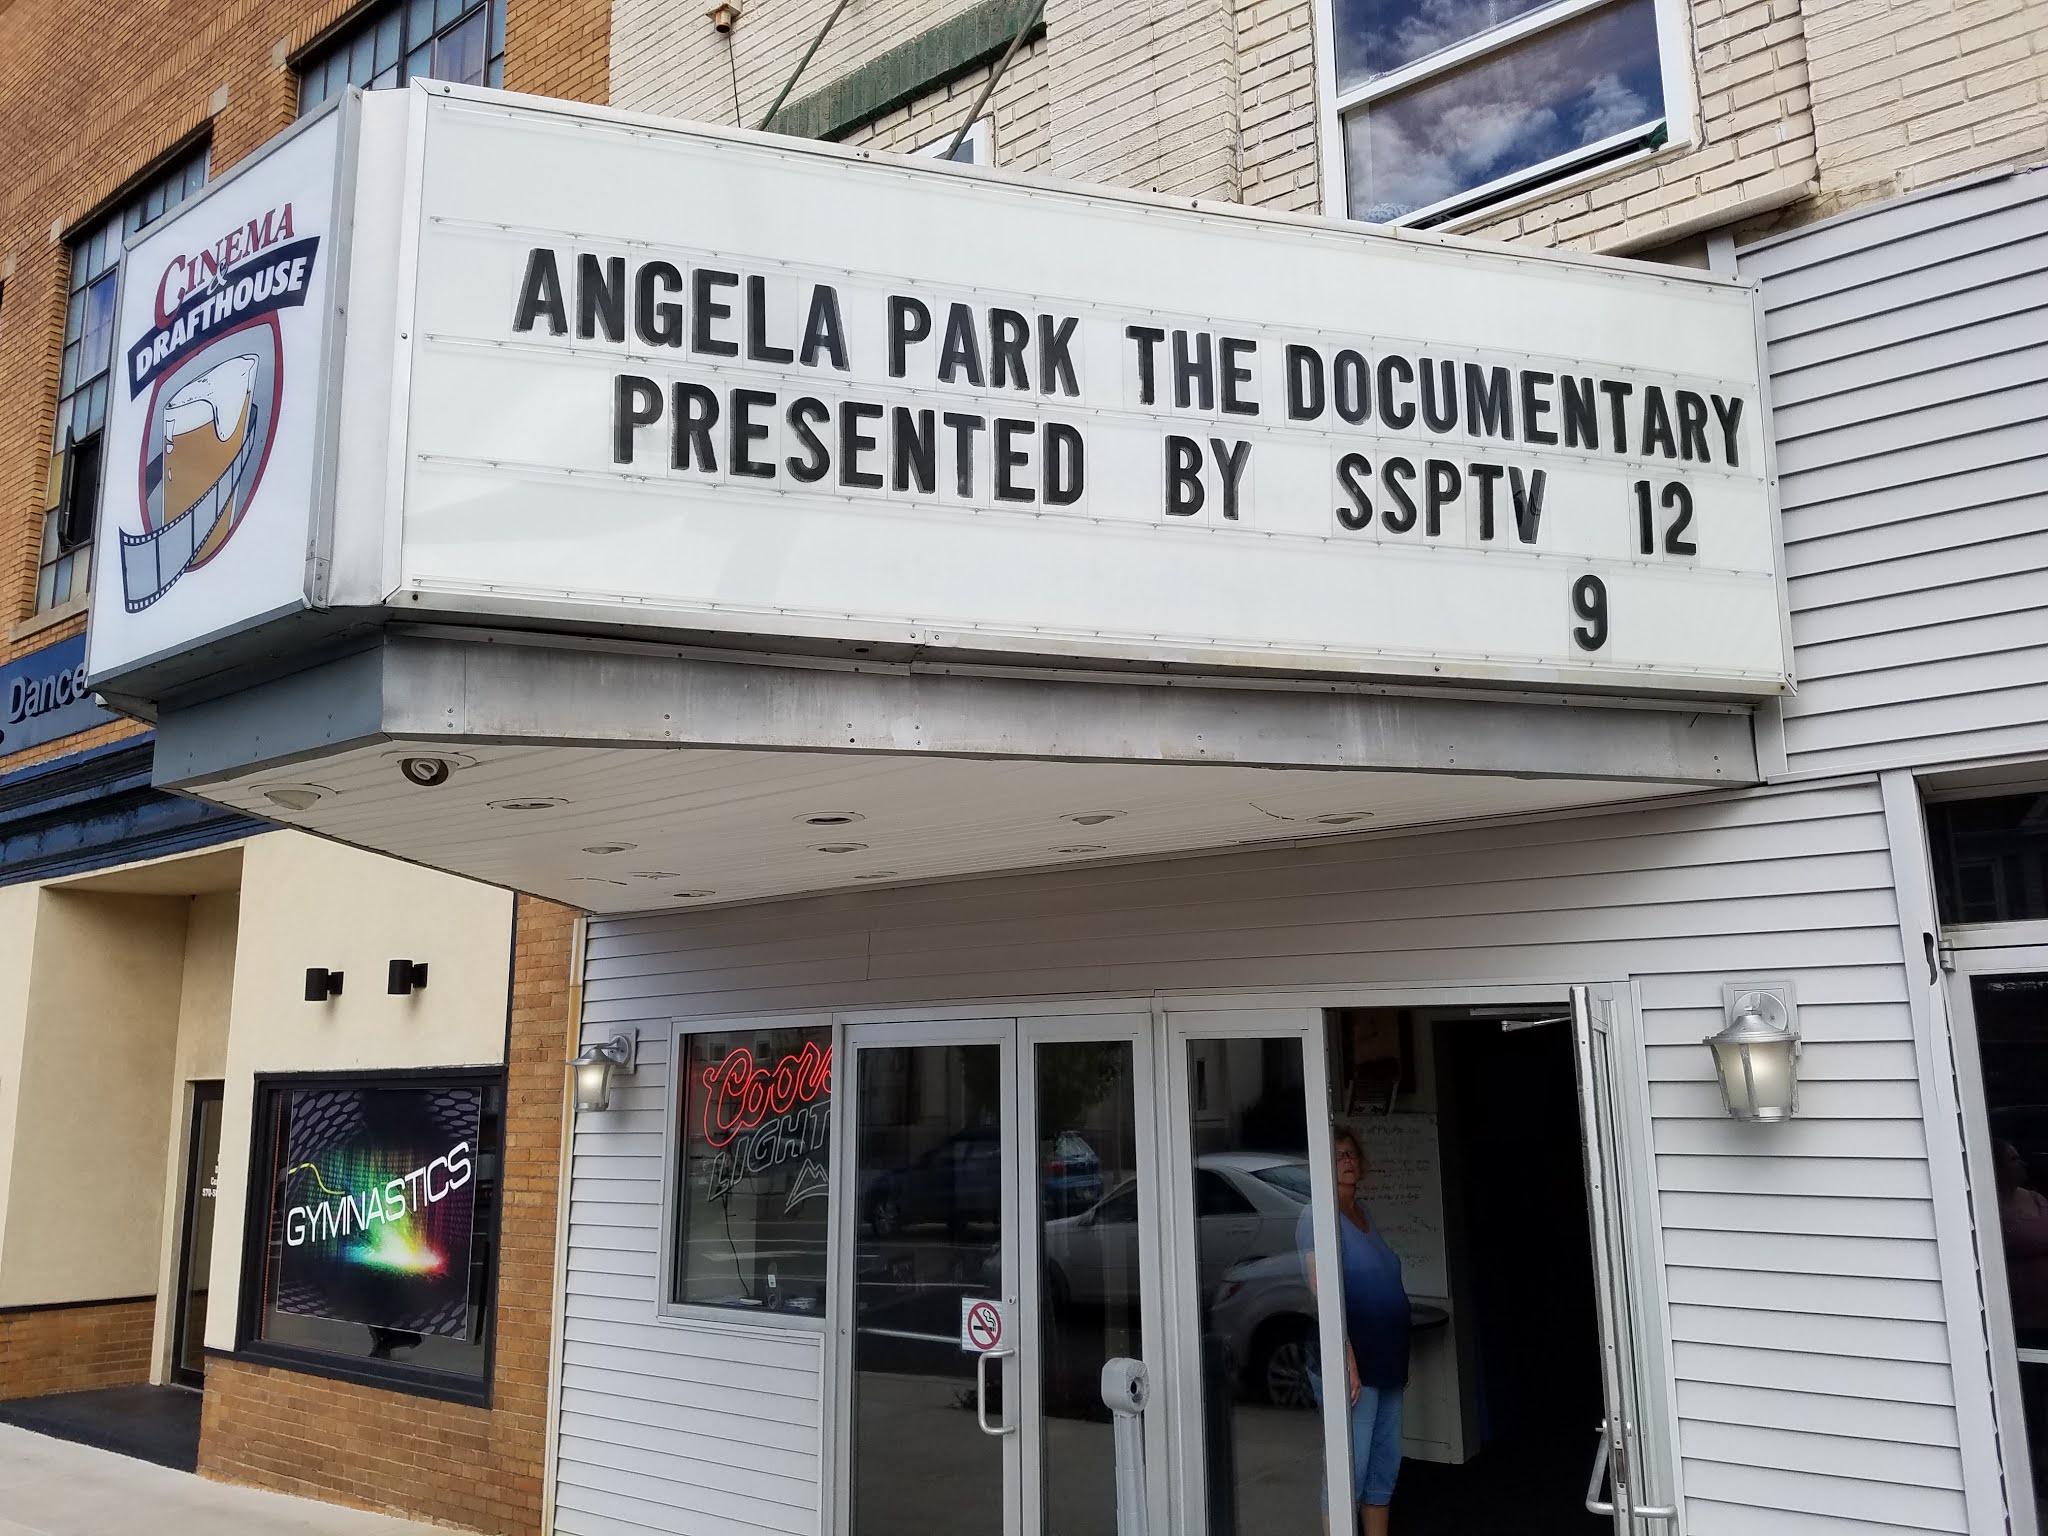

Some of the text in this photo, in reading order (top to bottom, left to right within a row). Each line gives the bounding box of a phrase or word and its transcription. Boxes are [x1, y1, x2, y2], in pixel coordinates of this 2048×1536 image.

[136, 256, 308, 382] DRAFTHOUSE
[155, 202, 295, 330] CINEMA
[206, 257, 230, 296] &
[512, 247, 1745, 468] ANGELA PARK THE DOCUMENTARY
[613, 373, 1698, 556] PRESENTED BY SSPTV 12
[1571, 573, 1610, 652] 9
[9, 662, 88, 721] Dance
[286, 1141, 472, 1247] GYMNASTICS
[707, 1099, 832, 1202] LIGHT
